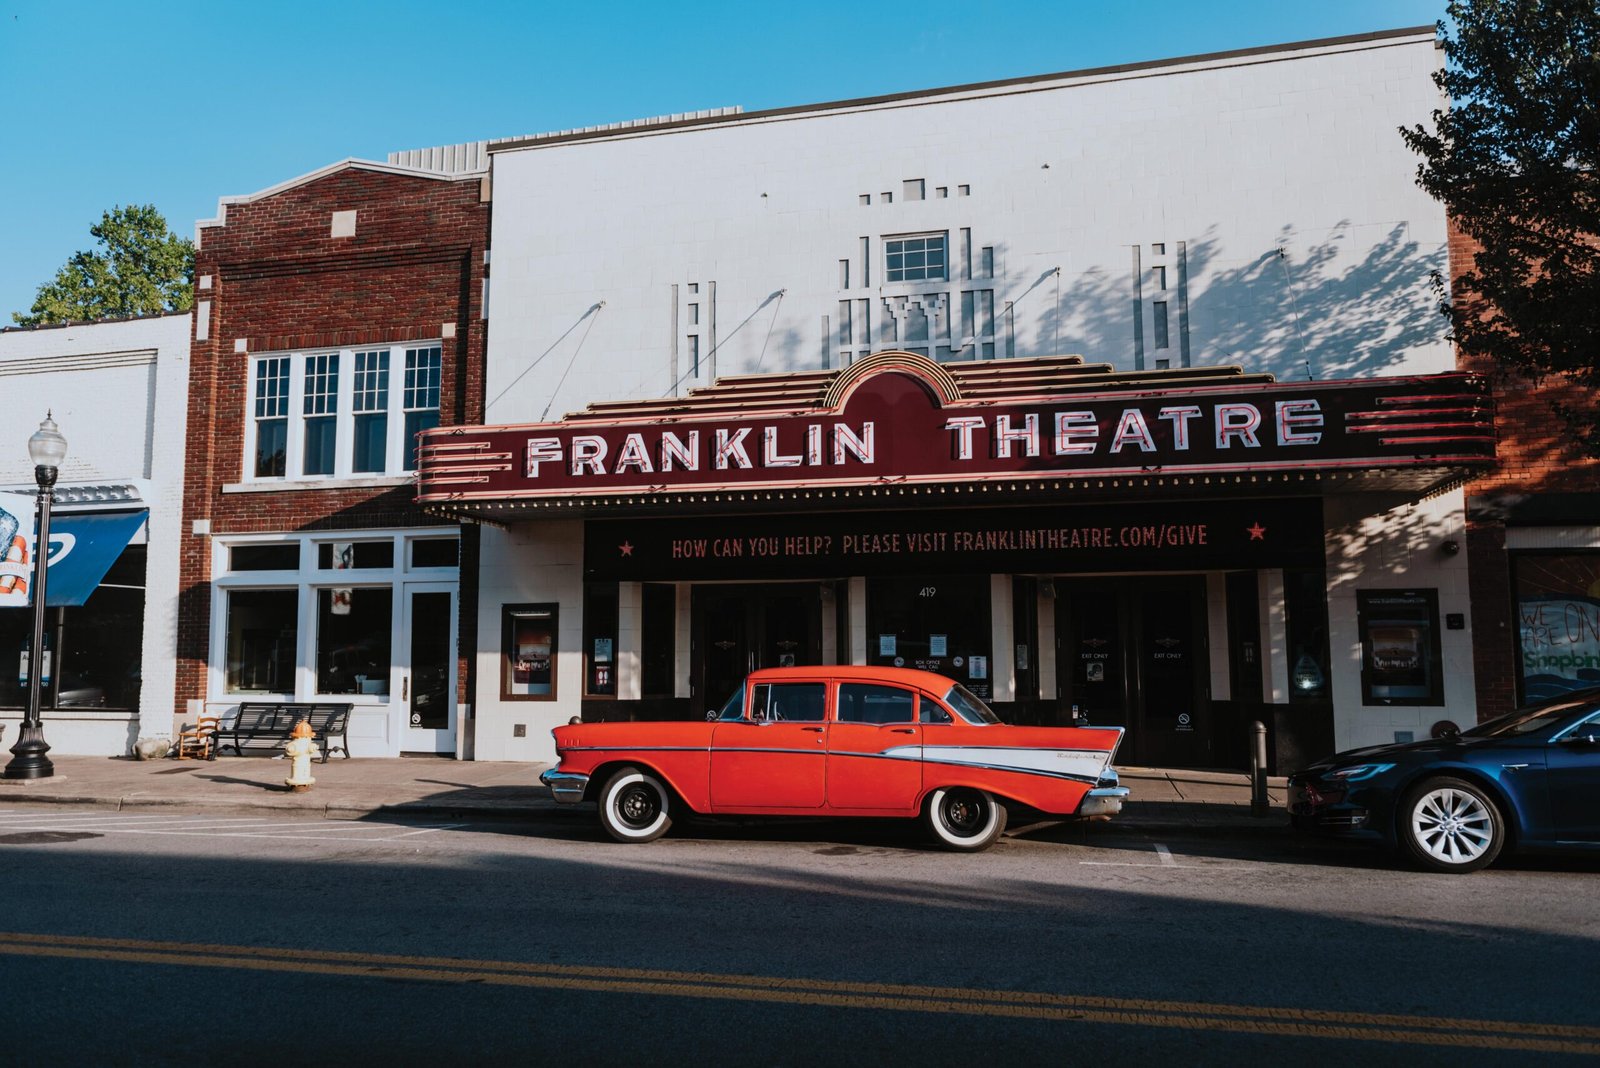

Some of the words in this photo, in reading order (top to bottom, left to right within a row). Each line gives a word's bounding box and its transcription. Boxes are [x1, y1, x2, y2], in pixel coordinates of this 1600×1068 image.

[525, 421, 875, 478] FRANKLIN
[944, 398, 1324, 460] THEATRE
[672, 539, 708, 558] HOW
[713, 538, 743, 557] CAN
[749, 537, 779, 556] YOU
[785, 535, 832, 555] HELP?
[842, 533, 901, 554] PLEASE
[906, 532, 947, 553] VISIT
[953, 524, 1208, 551] FRANKLINTHEATRE.COM/GIVE
[919, 586, 937, 597] 419
[1520, 604, 1552, 626] WE
[1522, 626, 1562, 648] ARE
